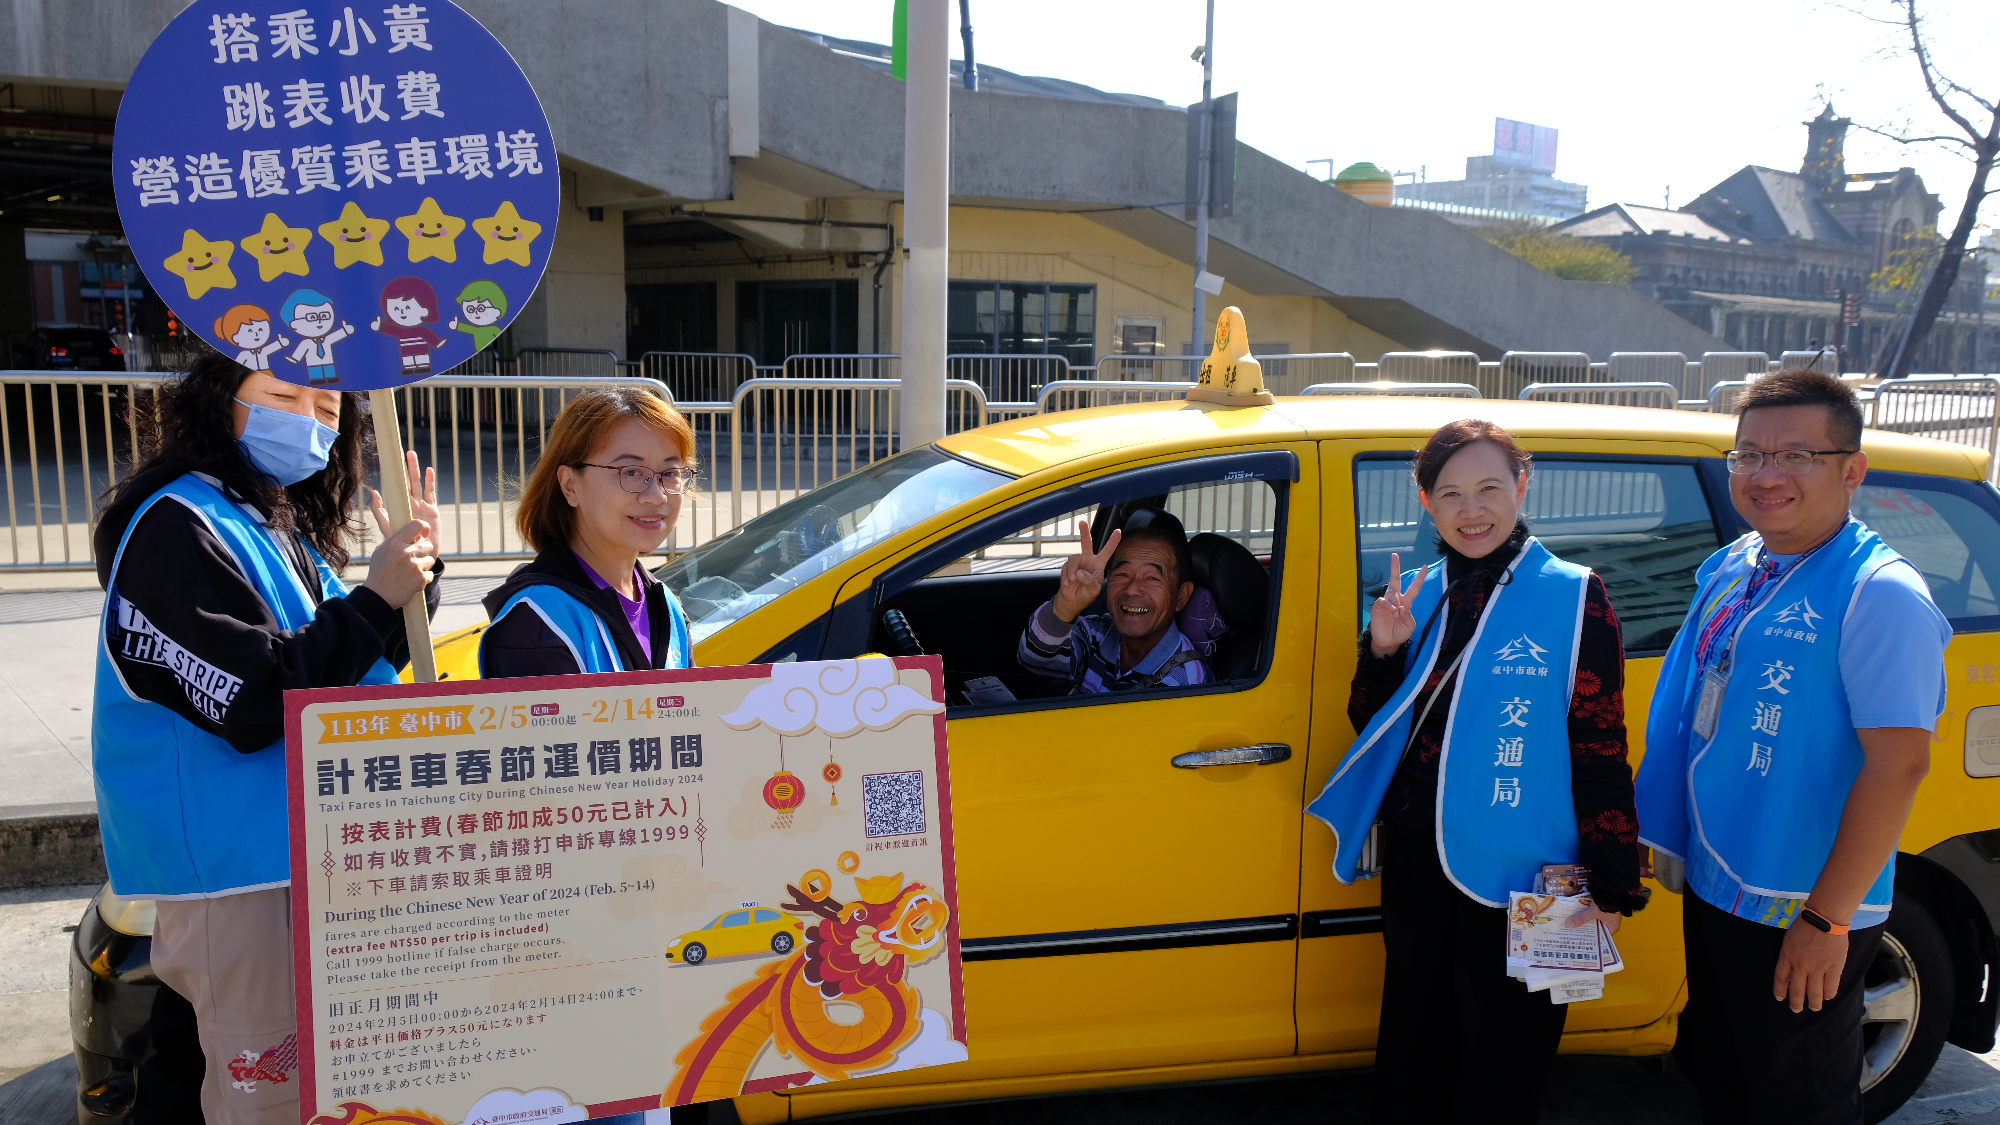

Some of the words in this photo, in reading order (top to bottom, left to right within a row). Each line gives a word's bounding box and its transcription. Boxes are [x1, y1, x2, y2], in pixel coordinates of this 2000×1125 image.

[207, 3, 433, 64] 搭乘小黃
[222, 70, 445, 132] 跳表收費
[130, 129, 544, 207] 營造優質乘車環境
[1223, 471, 1254, 480] WISH
[1763, 626, 1818, 644] 臺中市政府
[1491, 665, 1549, 677] 臺中市政府
[1966, 664, 2000, 685] 乘客
[330, 715, 391, 736] 113年
[399, 710, 463, 734] 臺中市
[479, 705, 528, 730] 2/5
[531, 714, 577, 727] 00:00起
[657, 706, 701, 719] 24:00止
[1745, 659, 1796, 777] 交通局
[316, 734, 703, 796] 計程車春節運價期間
[1490, 696, 1532, 808] 交通局
[319, 802, 344, 813] Taxi
[349, 801, 382, 811] Fares
[385, 798, 397, 808] In
[400, 794, 456, 806] Taichung
[459, 791, 483, 802] City
[487, 788, 526, 799] During
[529, 784, 574, 796] Chinese
[578, 782, 601, 792] New
[605, 780, 629, 790] Year
[632, 776, 675, 788] Holiday
[678, 774, 704, 784] 2024
[324, 907, 376, 923] During
[379, 904, 403, 918] the
[406, 900, 463, 915] Chinese
[466, 896, 496, 909] New
[500, 892, 530, 906] Year
[533, 888, 548, 902] of
[549, 886, 581, 900] 2024
[584, 882, 617, 898] (Feb.
[619, 878, 655, 893] 5~14)
[325, 931, 356, 942] fares
[360, 928, 380, 938] are
[384, 921, 432, 935] charged
[436, 915, 495, 930] according
[499, 914, 511, 923] to
[514, 911, 533, 922] the
[537, 908, 571, 919] meter
[326, 944, 363, 957] (extra
[366, 941, 386, 951] fee
[390, 936, 427, 949] NT$50
[431, 934, 451, 946] per
[454, 931, 477, 942] trip
[480, 929, 491, 939] is
[494, 922, 549, 937] included)
[326, 958, 351, 971] Call
[356, 955, 383, 967] 1999
[387, 951, 431, 964] hotline
[435, 947, 444, 958] if
[447, 945, 476, 957] false
[480, 942, 519, 953] charge
[523, 937, 566, 948] occurs.
[327, 972, 367, 985] Please
[371, 968, 397, 980] take
[400, 966, 420, 977] the
[424, 961, 467, 974] receipt
[470, 958, 499, 968] from
[503, 954, 521, 965] the
[525, 951, 562, 962] meter.
[329, 990, 439, 1018] 旧正月期間中
[329, 1013, 547, 1051] 料金は平日価格プラス50元になります
[331, 1037, 481, 1067] お申立てがございましたら
[332, 1071, 471, 1099] 領収書を求めてください
